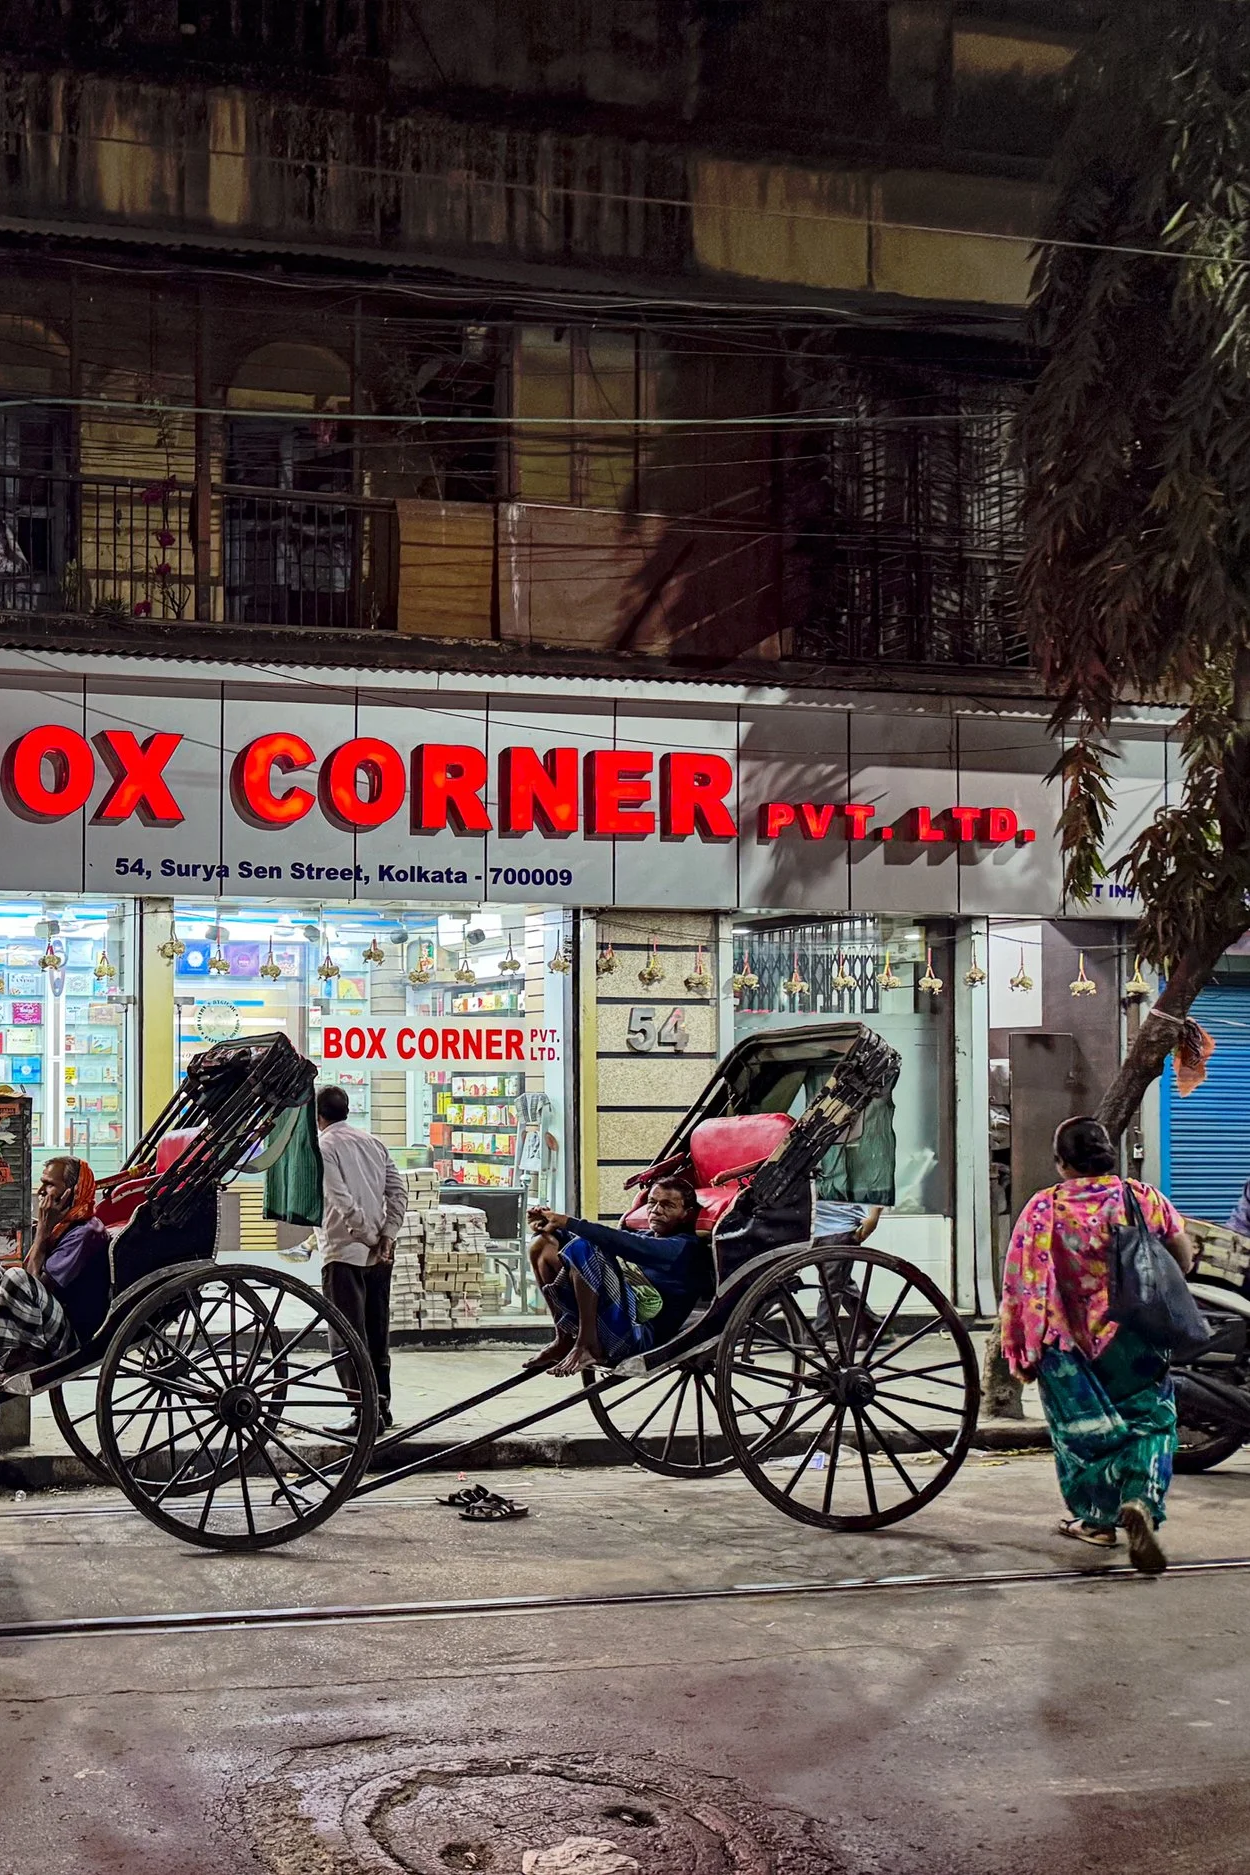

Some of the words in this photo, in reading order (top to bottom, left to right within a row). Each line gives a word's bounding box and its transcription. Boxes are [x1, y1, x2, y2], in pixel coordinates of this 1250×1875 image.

[241, 733, 739, 837] CORNER
[764, 803, 894, 839] PVT.
[916, 806, 1036, 841] LTD.
[114, 858, 152, 880] 54,
[161, 860, 230, 881] Surya
[238, 862, 282, 880] Sen
[290, 863, 370, 886] Street,
[378, 864, 468, 884] Kolkata
[489, 867, 573, 886] 700009
[323, 1027, 387, 1060] BOX
[396, 1027, 526, 1061] CORNER
[530, 1029, 560, 1043] PVT.
[626, 1007, 690, 1053] 54
[530, 1046, 560, 1061] LTD.
